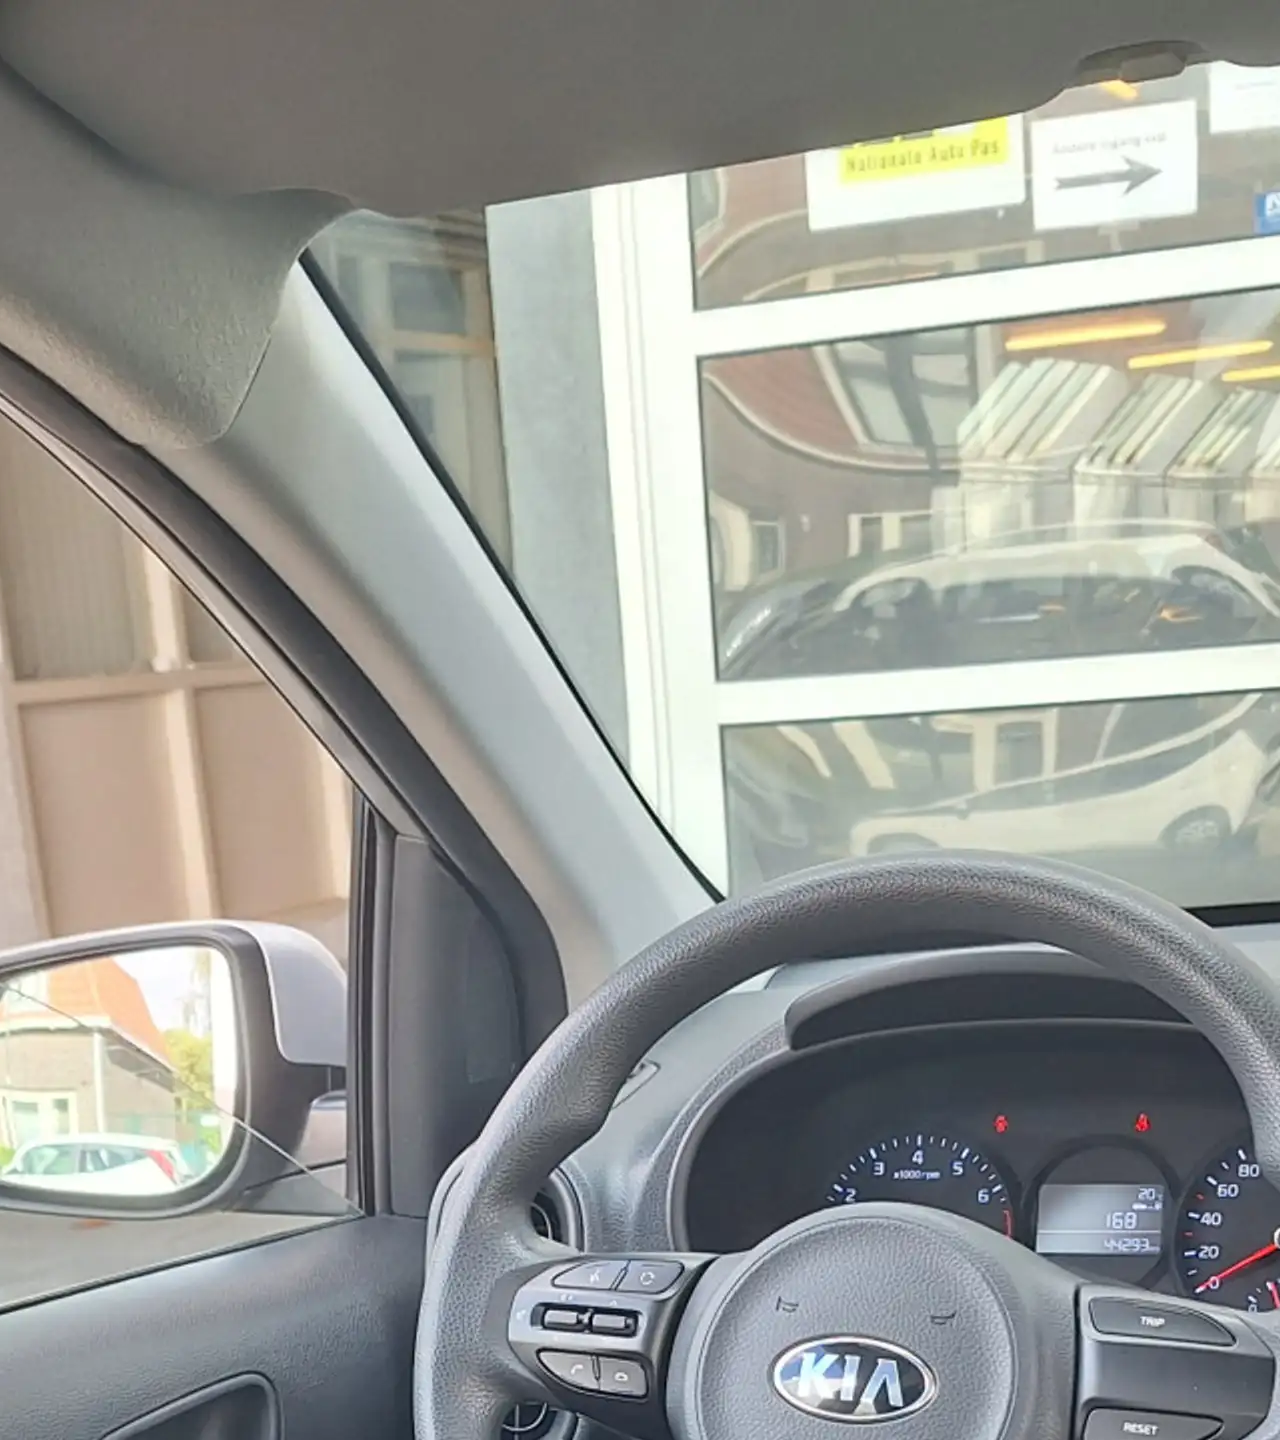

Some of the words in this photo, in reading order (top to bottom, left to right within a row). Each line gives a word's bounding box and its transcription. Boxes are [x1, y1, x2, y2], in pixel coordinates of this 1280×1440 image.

[929, 144, 965, 162] Auto
[971, 137, 1000, 157] Pas
[912, 1150, 924, 1165] 4
[873, 1162, 885, 1176] 3
[952, 1162, 964, 1176] 5
[1238, 1164, 1260, 1178] 80
[845, 1188, 857, 1202] 2
[978, 1188, 990, 1203] 6
[1217, 1184, 1239, 1197] 60
[1106, 1212, 1138, 1229] 168
[1200, 1212, 1222, 1226] 40
[1198, 1245, 1220, 1259] 20
[1209, 1276, 1220, 1289] 0
[1140, 1316, 1166, 1328] TRIP
[797, 1352, 904, 1408] KIA
[1123, 1422, 1159, 1436] RESET
